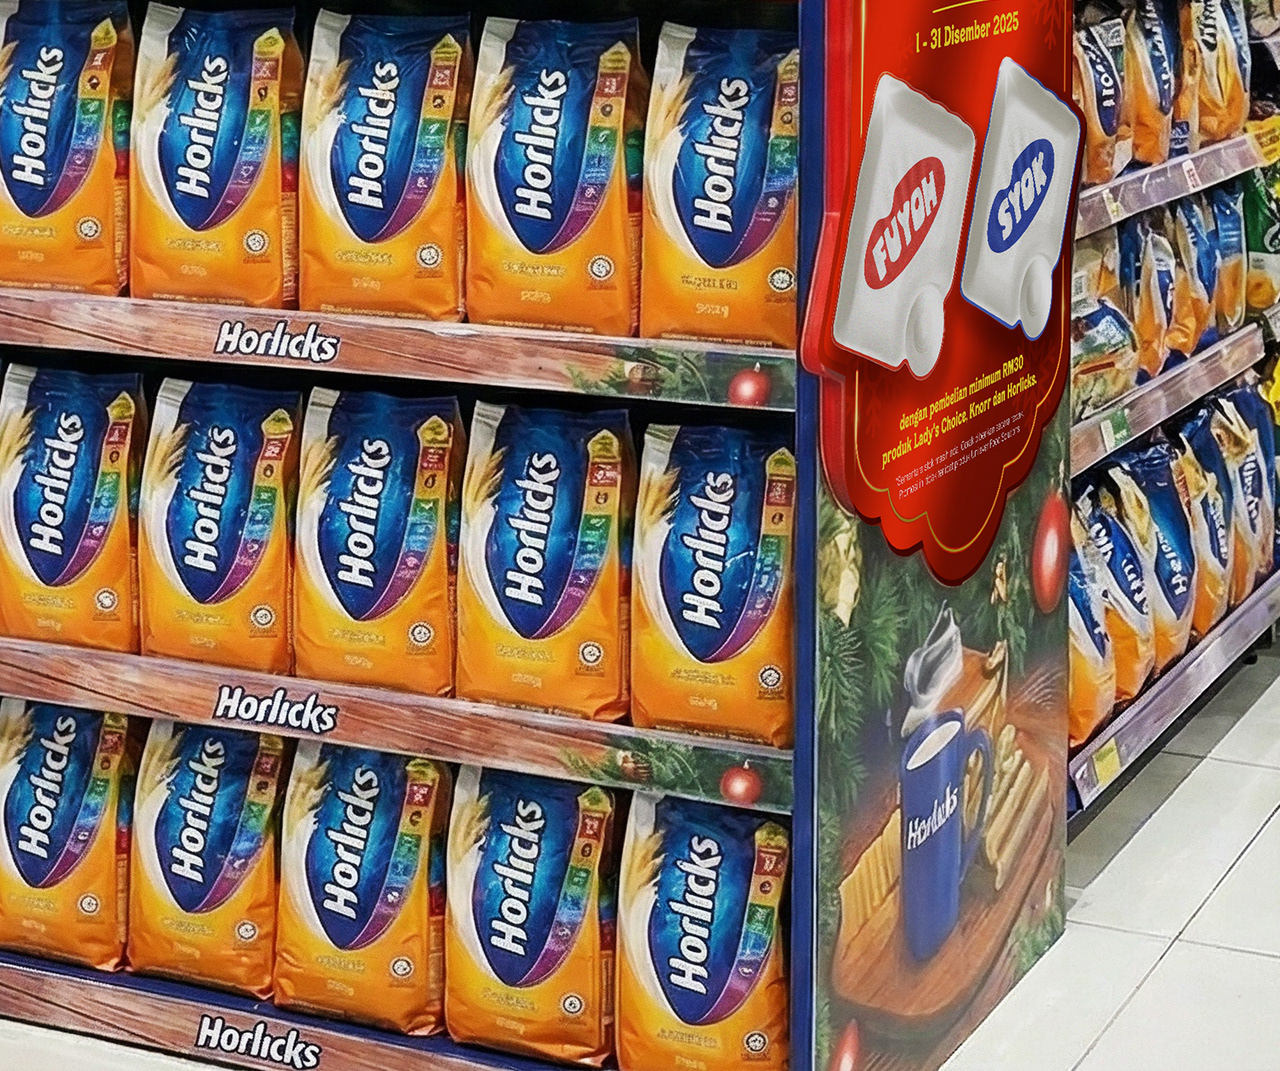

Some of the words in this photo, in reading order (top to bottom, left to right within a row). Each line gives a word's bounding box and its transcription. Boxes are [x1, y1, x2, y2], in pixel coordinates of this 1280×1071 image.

[915, 31, 920, 53] 1
[930, 27, 942, 50] 31
[944, 19, 991, 47] Disember
[993, 10, 1020, 36] 2025
[12, 46, 64, 186] Horlicks
[176, 54, 230, 198] Horlicks
[347, 60, 401, 210] Horlicks
[514, 68, 568, 221] Horlicks
[692, 77, 750, 233] Horlicks
[871, 170, 939, 282] FUYOH
[997, 151, 1048, 241] SYOK
[216, 321, 341, 362] Horlicks
[899, 405, 928, 431] dengan
[929, 386, 968, 420] pembelian
[969, 369, 1002, 396] minimum
[1002, 354, 1024, 378] RM30
[29, 411, 85, 557] Horlicks
[183, 426, 235, 571] Horlicks
[881, 436, 913, 470] produk
[914, 423, 940, 448] Lady's
[969, 397, 992, 420] Knorr
[993, 390, 1006, 410] dan
[337, 437, 392, 588] Horlicks
[505, 451, 561, 606] Horlicks
[682, 471, 737, 629] Horlicks
[216, 687, 337, 733] Horlicks
[18, 715, 77, 860] Horlicks
[170, 736, 226, 884] Horlicks
[323, 765, 380, 920] Horlicks
[489, 799, 546, 956] Horlicks
[669, 834, 722, 995] Horlicks
[196, 1015, 321, 1070] Horlicks
